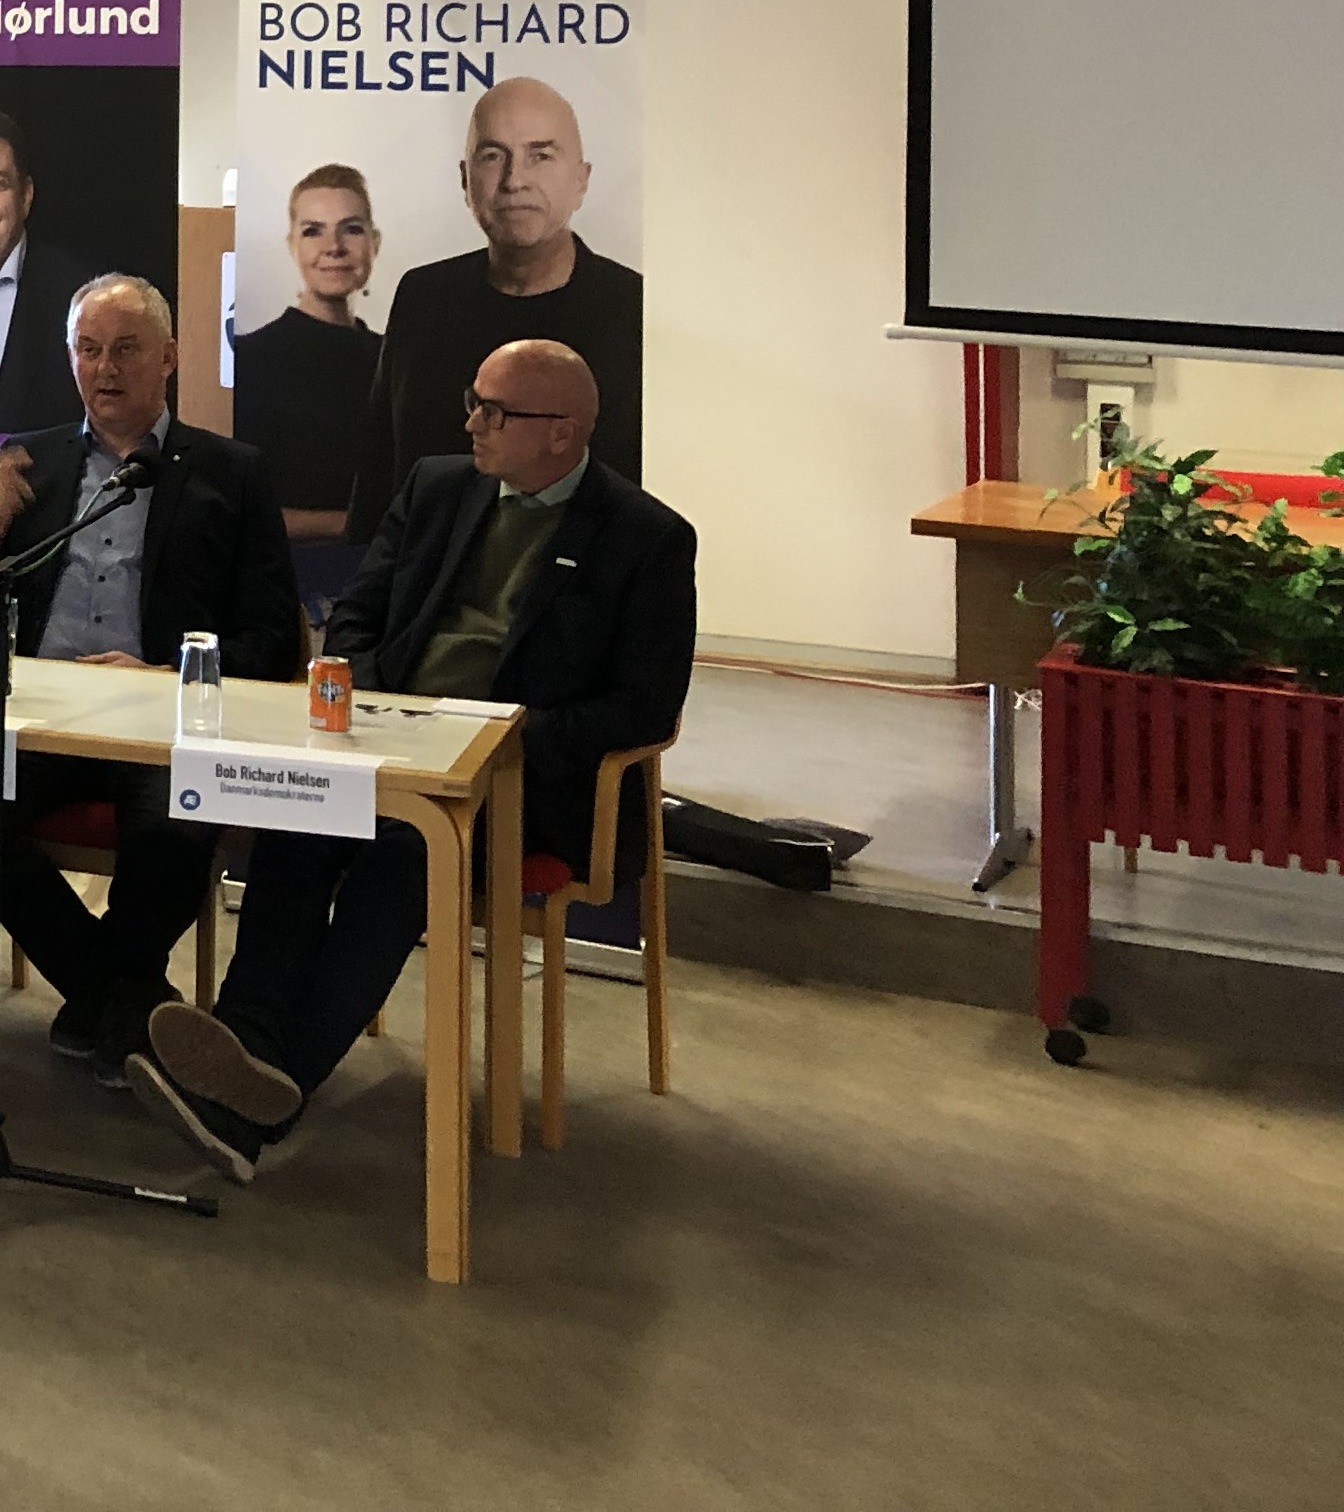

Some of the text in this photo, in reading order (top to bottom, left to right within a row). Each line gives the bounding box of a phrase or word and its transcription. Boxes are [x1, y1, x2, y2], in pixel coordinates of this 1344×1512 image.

[260, 2, 630, 45] BOB RICHARD
[258, 49, 495, 92] NIELSEN
[215, 763, 330, 789] Bob Richard Nielsen
